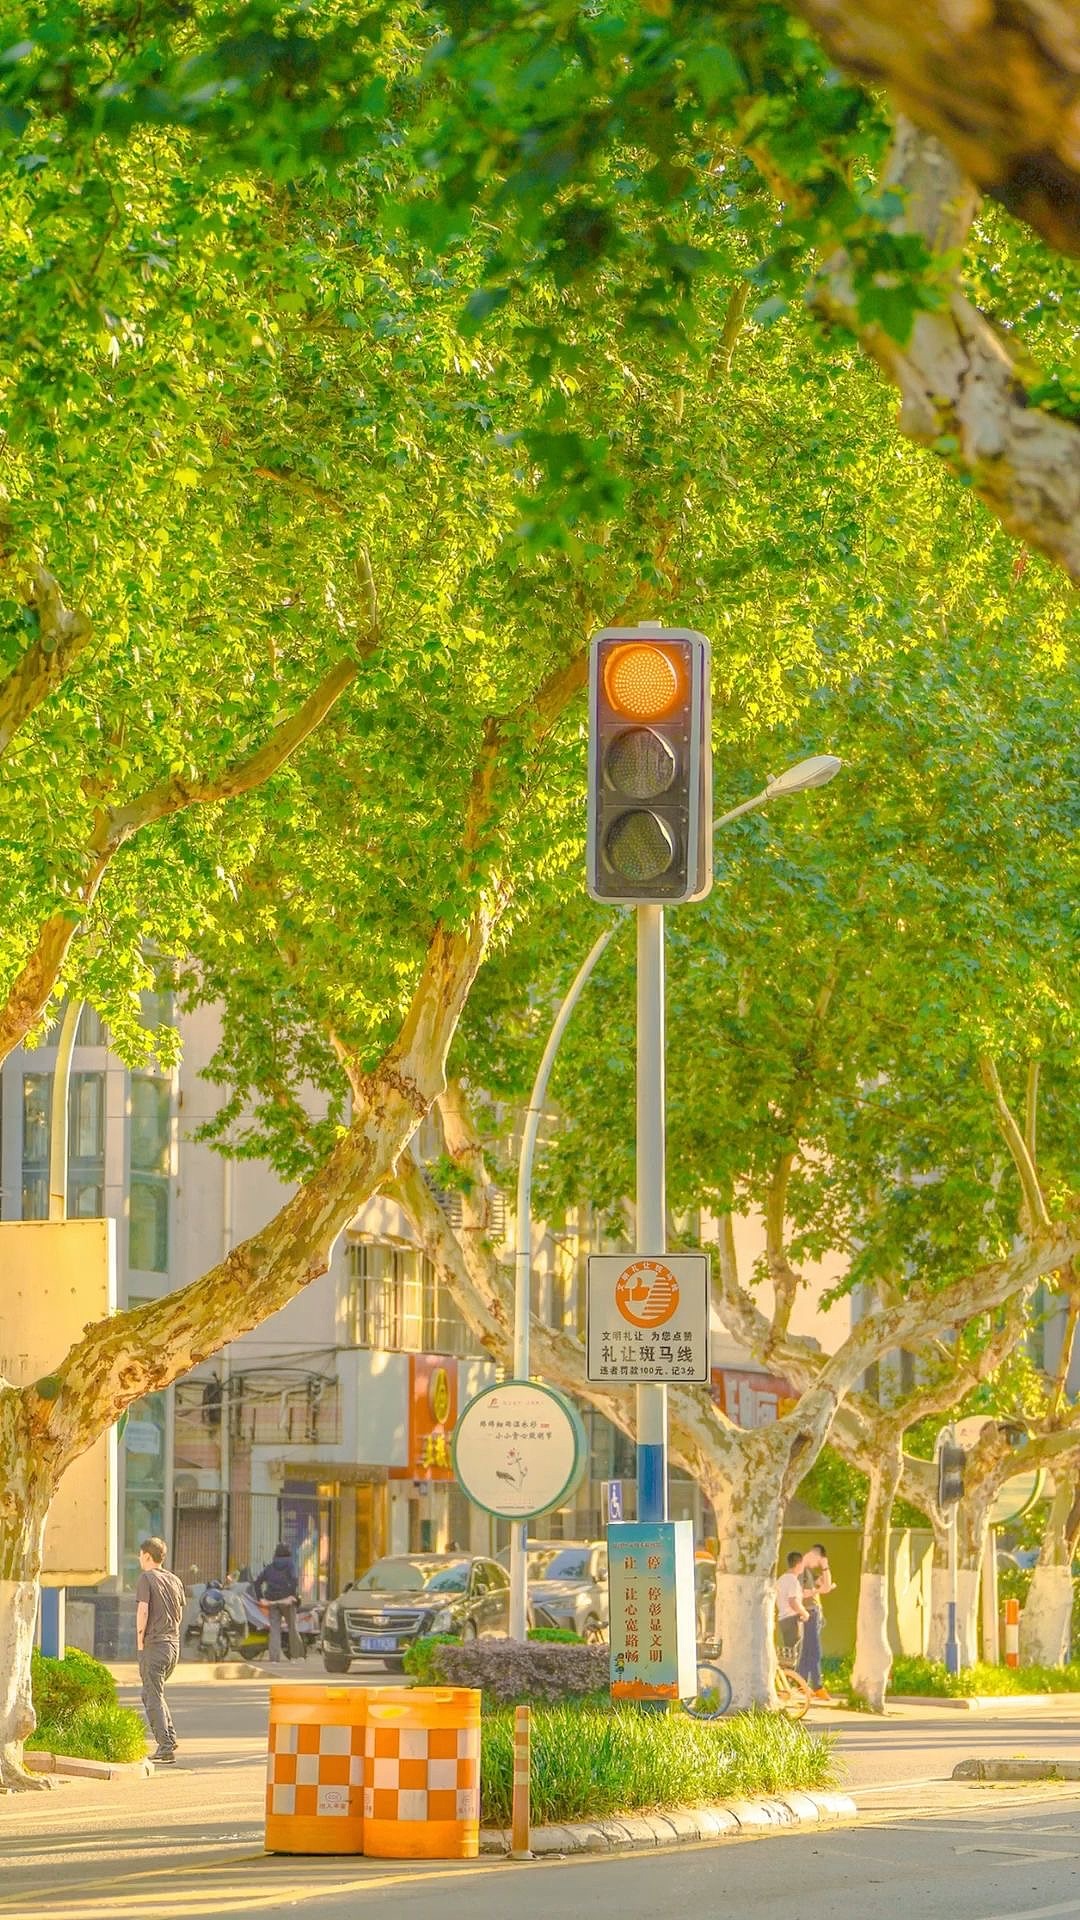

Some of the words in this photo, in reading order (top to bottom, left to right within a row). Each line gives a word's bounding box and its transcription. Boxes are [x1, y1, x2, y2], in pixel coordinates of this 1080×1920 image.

[601, 1331, 643, 1341] 文明礼让
[651, 1331, 693, 1341] 为您点赞
[601, 1345, 693, 1363] 礼让斑马线
[624, 1555, 640, 1663] 让一让心宽路畅
[647, 1555, 663, 1663] 停一停彰显文明
